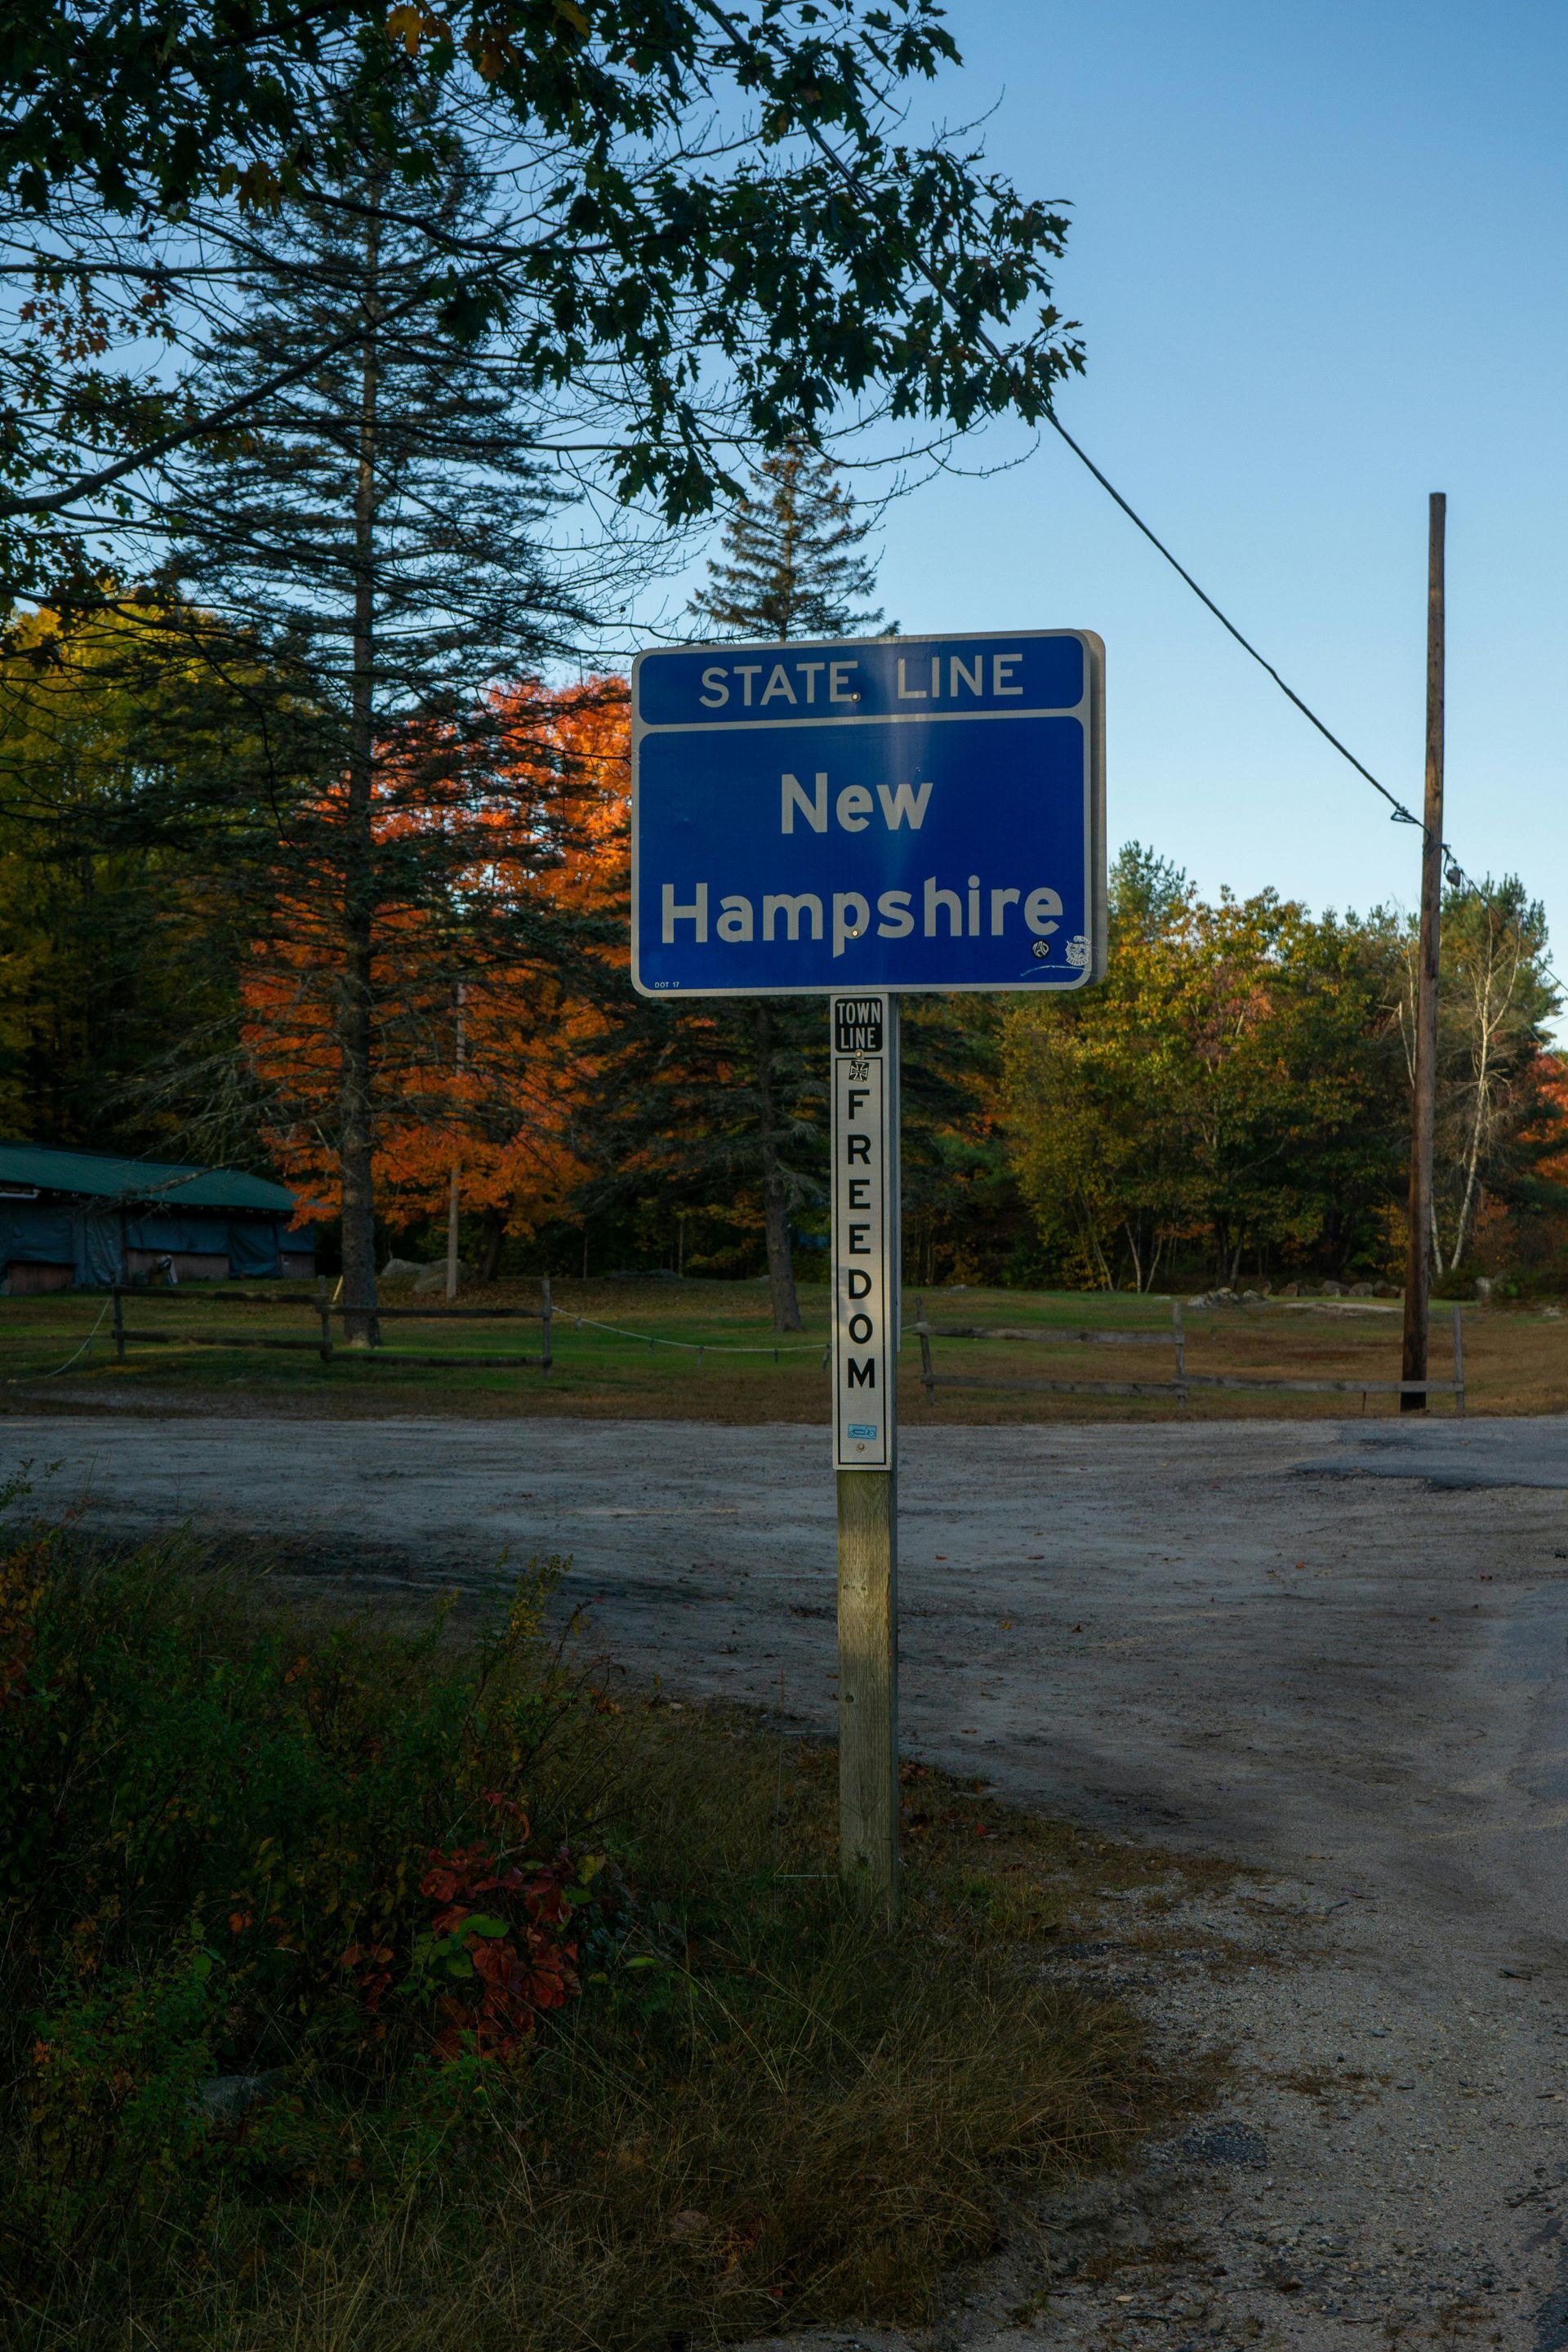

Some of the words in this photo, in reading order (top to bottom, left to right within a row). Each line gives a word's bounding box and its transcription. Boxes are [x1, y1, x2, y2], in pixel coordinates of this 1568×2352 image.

[699, 660, 859, 708] STATE
[898, 653, 1023, 699] LINE
[781, 772, 933, 835] New
[662, 875, 1063, 959] Hampshire
[836, 1001, 881, 1024] TOWN
[840, 1027, 876, 1049] LINE
[848, 1089, 875, 1389] FREEDOM
